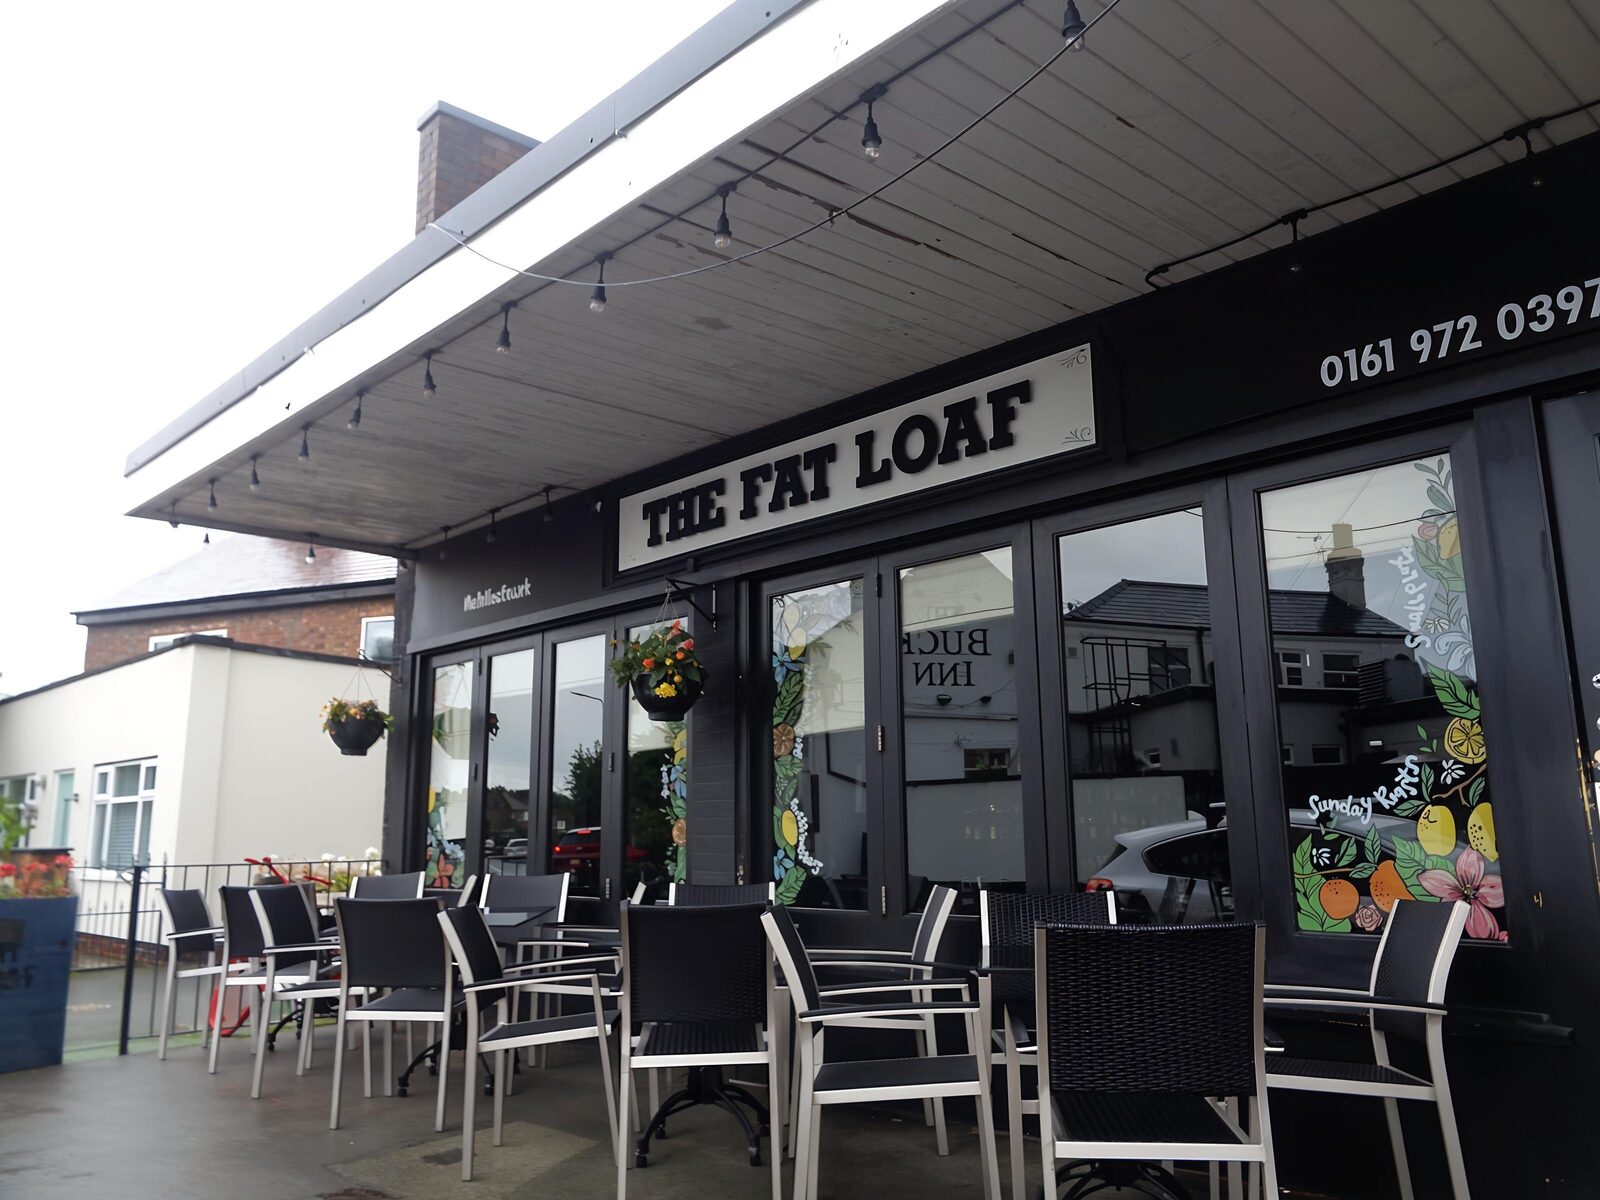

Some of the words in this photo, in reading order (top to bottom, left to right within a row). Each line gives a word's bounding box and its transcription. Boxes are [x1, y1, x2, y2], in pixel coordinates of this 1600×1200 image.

[1320, 337, 1395, 387] 0161
[1410, 315, 1483, 364] 972
[642, 477, 725, 548] THE
[739, 443, 836, 520] FAT
[855, 379, 1031, 489] LOAF
[1307, 794, 1372, 825] Sunday
